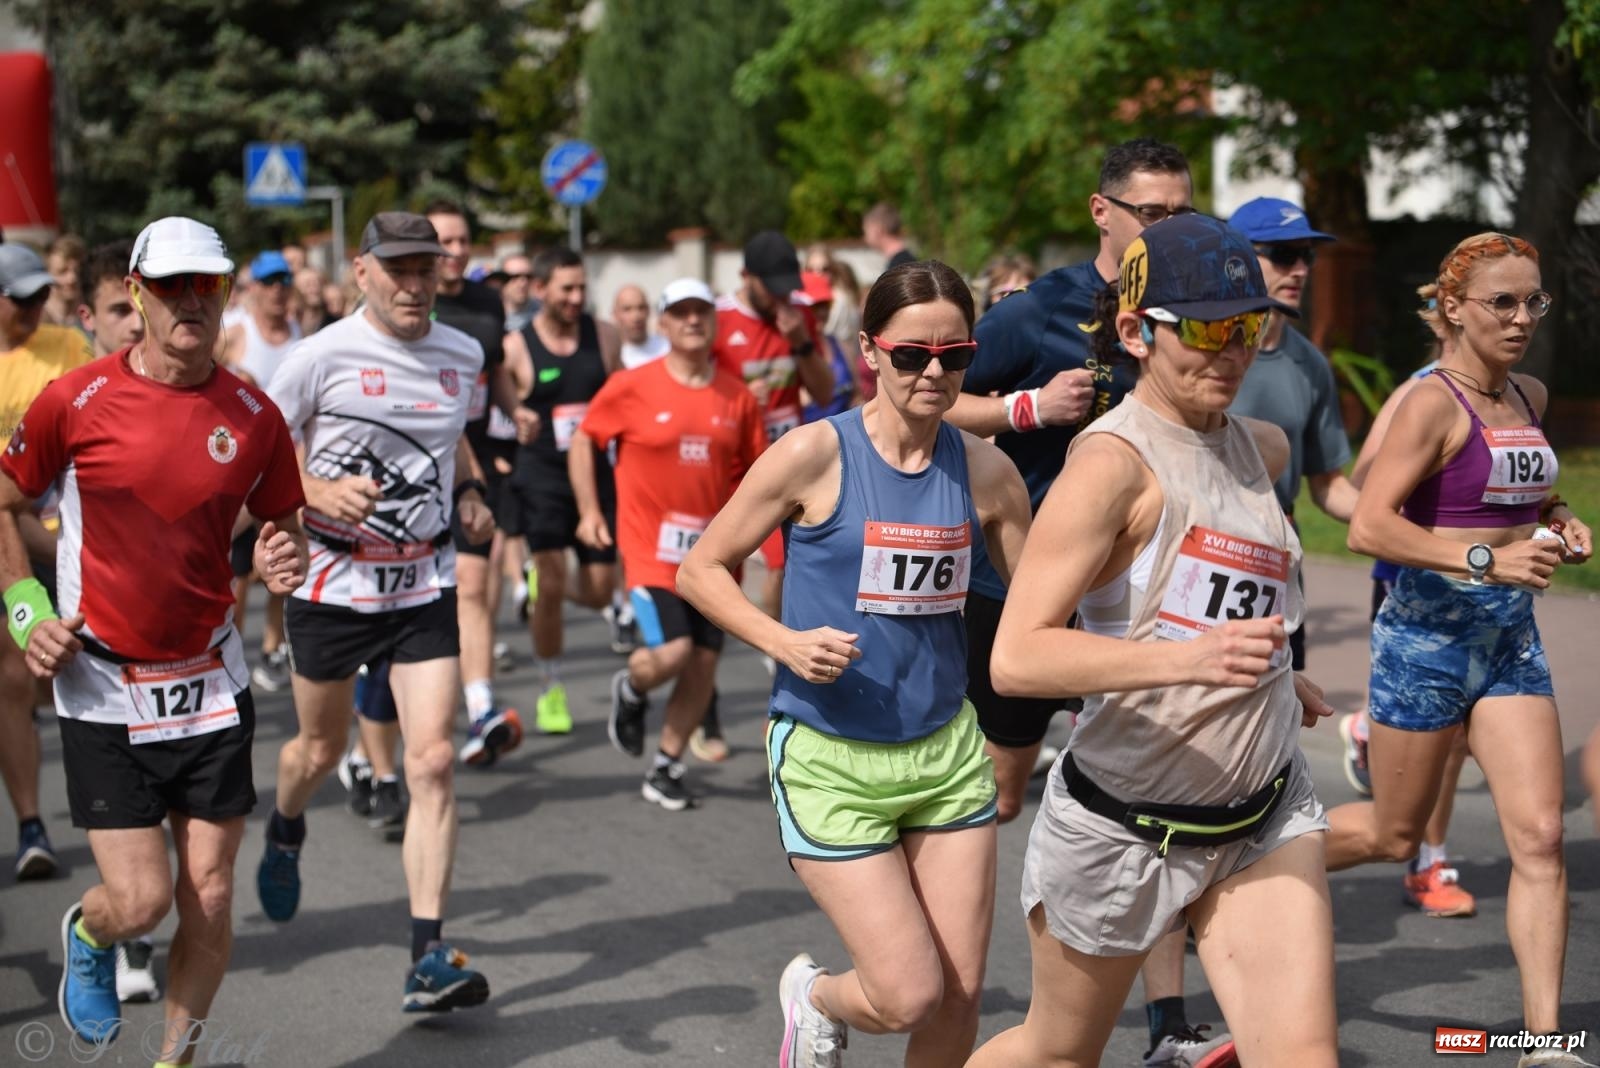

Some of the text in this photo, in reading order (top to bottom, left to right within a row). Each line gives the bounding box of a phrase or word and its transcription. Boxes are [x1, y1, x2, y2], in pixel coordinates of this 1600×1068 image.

[236, 387, 264, 415] BORN
[1506, 451, 1544, 483] 192
[881, 526, 898, 535] XVI
[900, 528, 921, 537] BIEG
[923, 529, 941, 539] BEZ
[1204, 534, 1225, 548] XVI
[1226, 540, 1252, 556] BIEG
[374, 564, 417, 594] 179
[892, 554, 955, 591] 176
[1204, 571, 1277, 621] 137
[150, 678, 205, 718] 127
